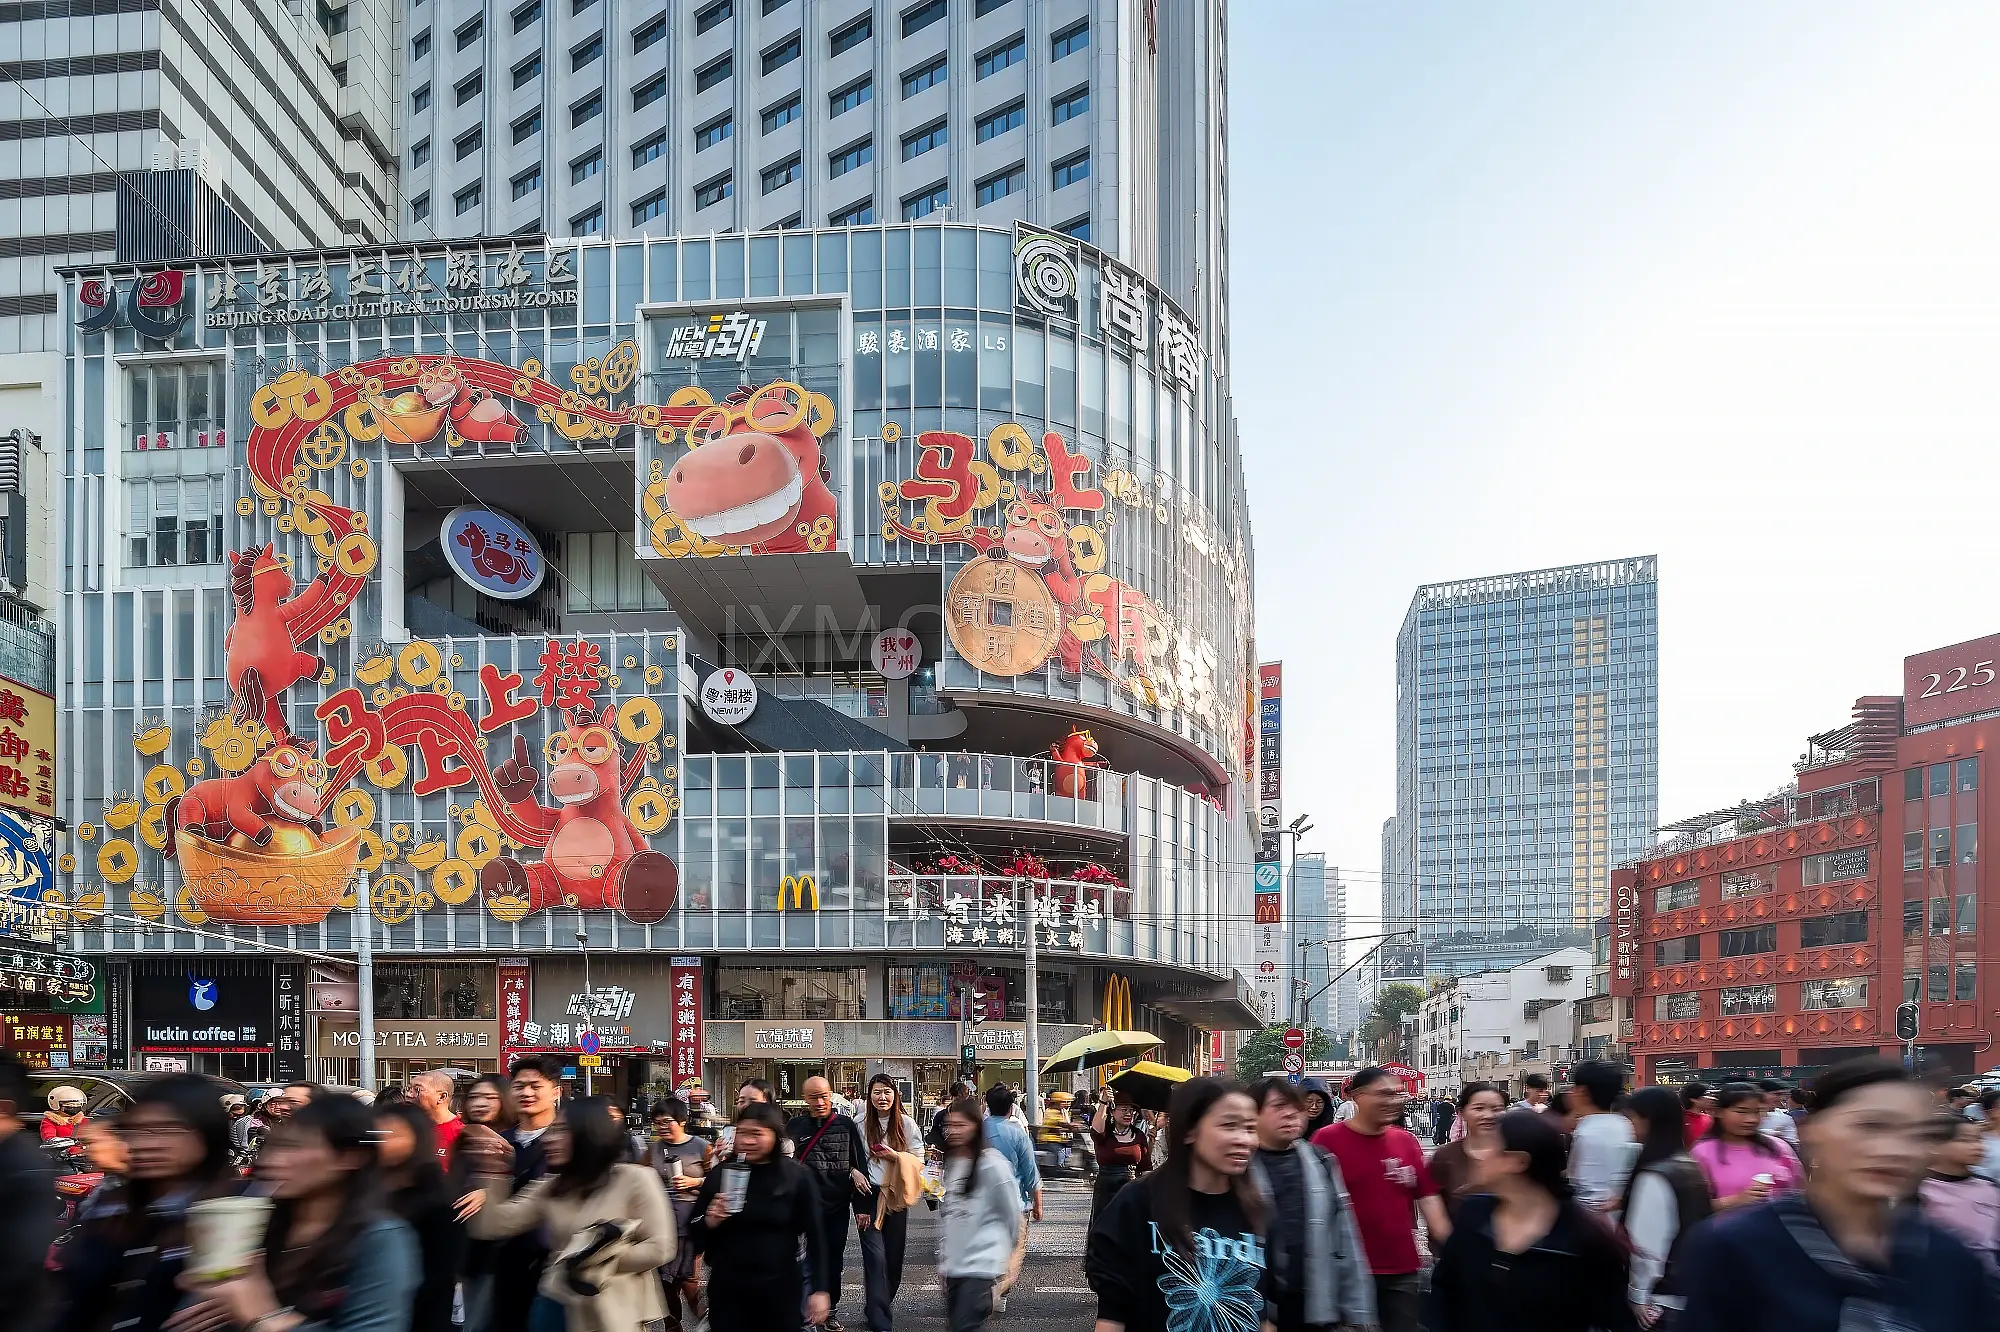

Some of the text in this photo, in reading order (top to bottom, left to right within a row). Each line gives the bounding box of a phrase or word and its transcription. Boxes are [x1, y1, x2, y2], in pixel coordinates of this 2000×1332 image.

[204, 290, 578, 331] BEIJING ROAD CULTURAL TOURISM ZONE
[857, 327, 1007, 355] 駿豪酒家 L5
[493, 531, 532, 557] 马年
[880, 636, 897, 653] 我
[880, 654, 914, 671] 广州
[1919, 659, 1996, 699] 225
[1617, 886, 1631, 939] GOELIA
[946, 926, 1085, 949] 海鲜粥火锅
[503, 978, 525, 990] 广东
[1723, 994, 1775, 1008] 不一样的
[279, 974, 293, 1051] 云昕水语
[12, 1025, 54, 1041] 百润堂
[147, 1026, 236, 1042] luckin coffee
[597, 1026, 619, 1034] NEW
[754, 1028, 814, 1043] 六福珠寶
[967, 1029, 1025, 1044] 六福珠寶
[333, 1031, 388, 1047] MOLY
[391, 1031, 428, 1047] TEA
[965, 1048, 974, 1058] 13
